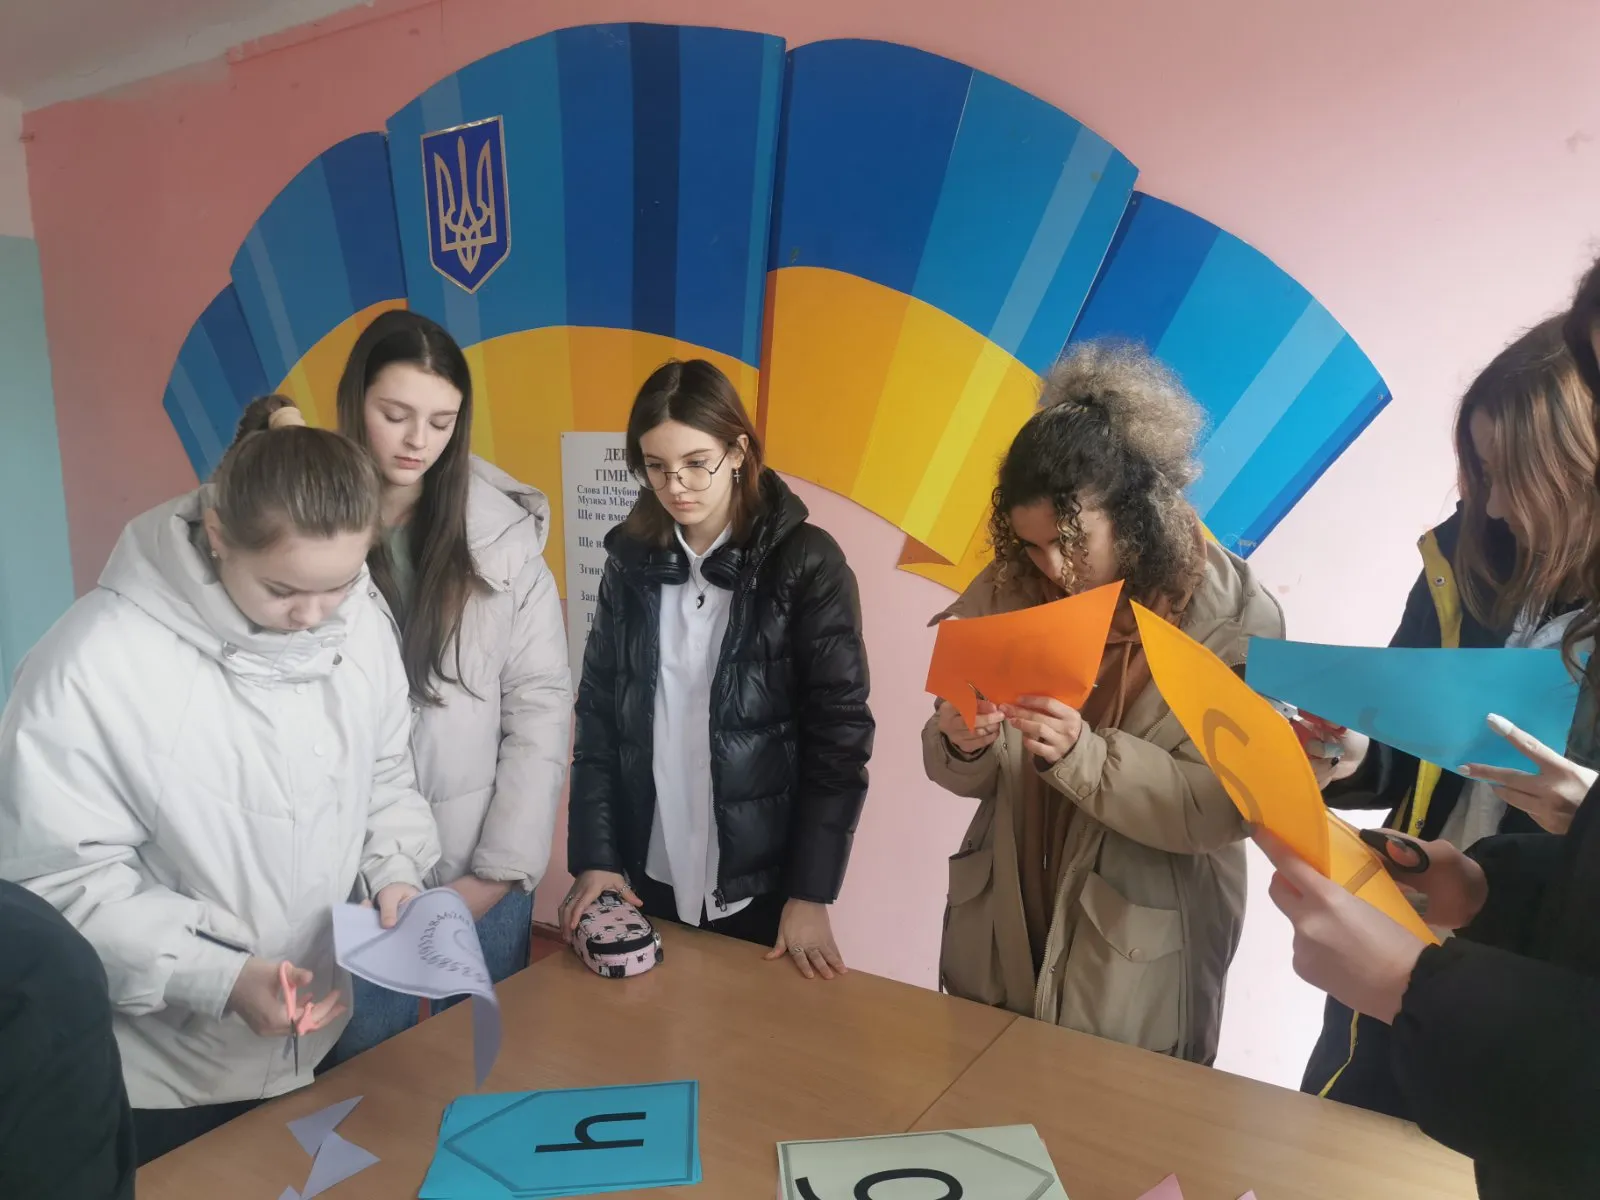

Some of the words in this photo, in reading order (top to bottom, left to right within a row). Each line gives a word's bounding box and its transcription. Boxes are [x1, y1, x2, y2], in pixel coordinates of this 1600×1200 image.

[595, 469, 628, 482] ГІМН
[577, 484, 600, 495] Слова
[577, 495, 607, 507] Музика
[577, 508, 593, 521] Ще
[595, 512, 606, 521] не
[578, 536, 594, 549] Ще
